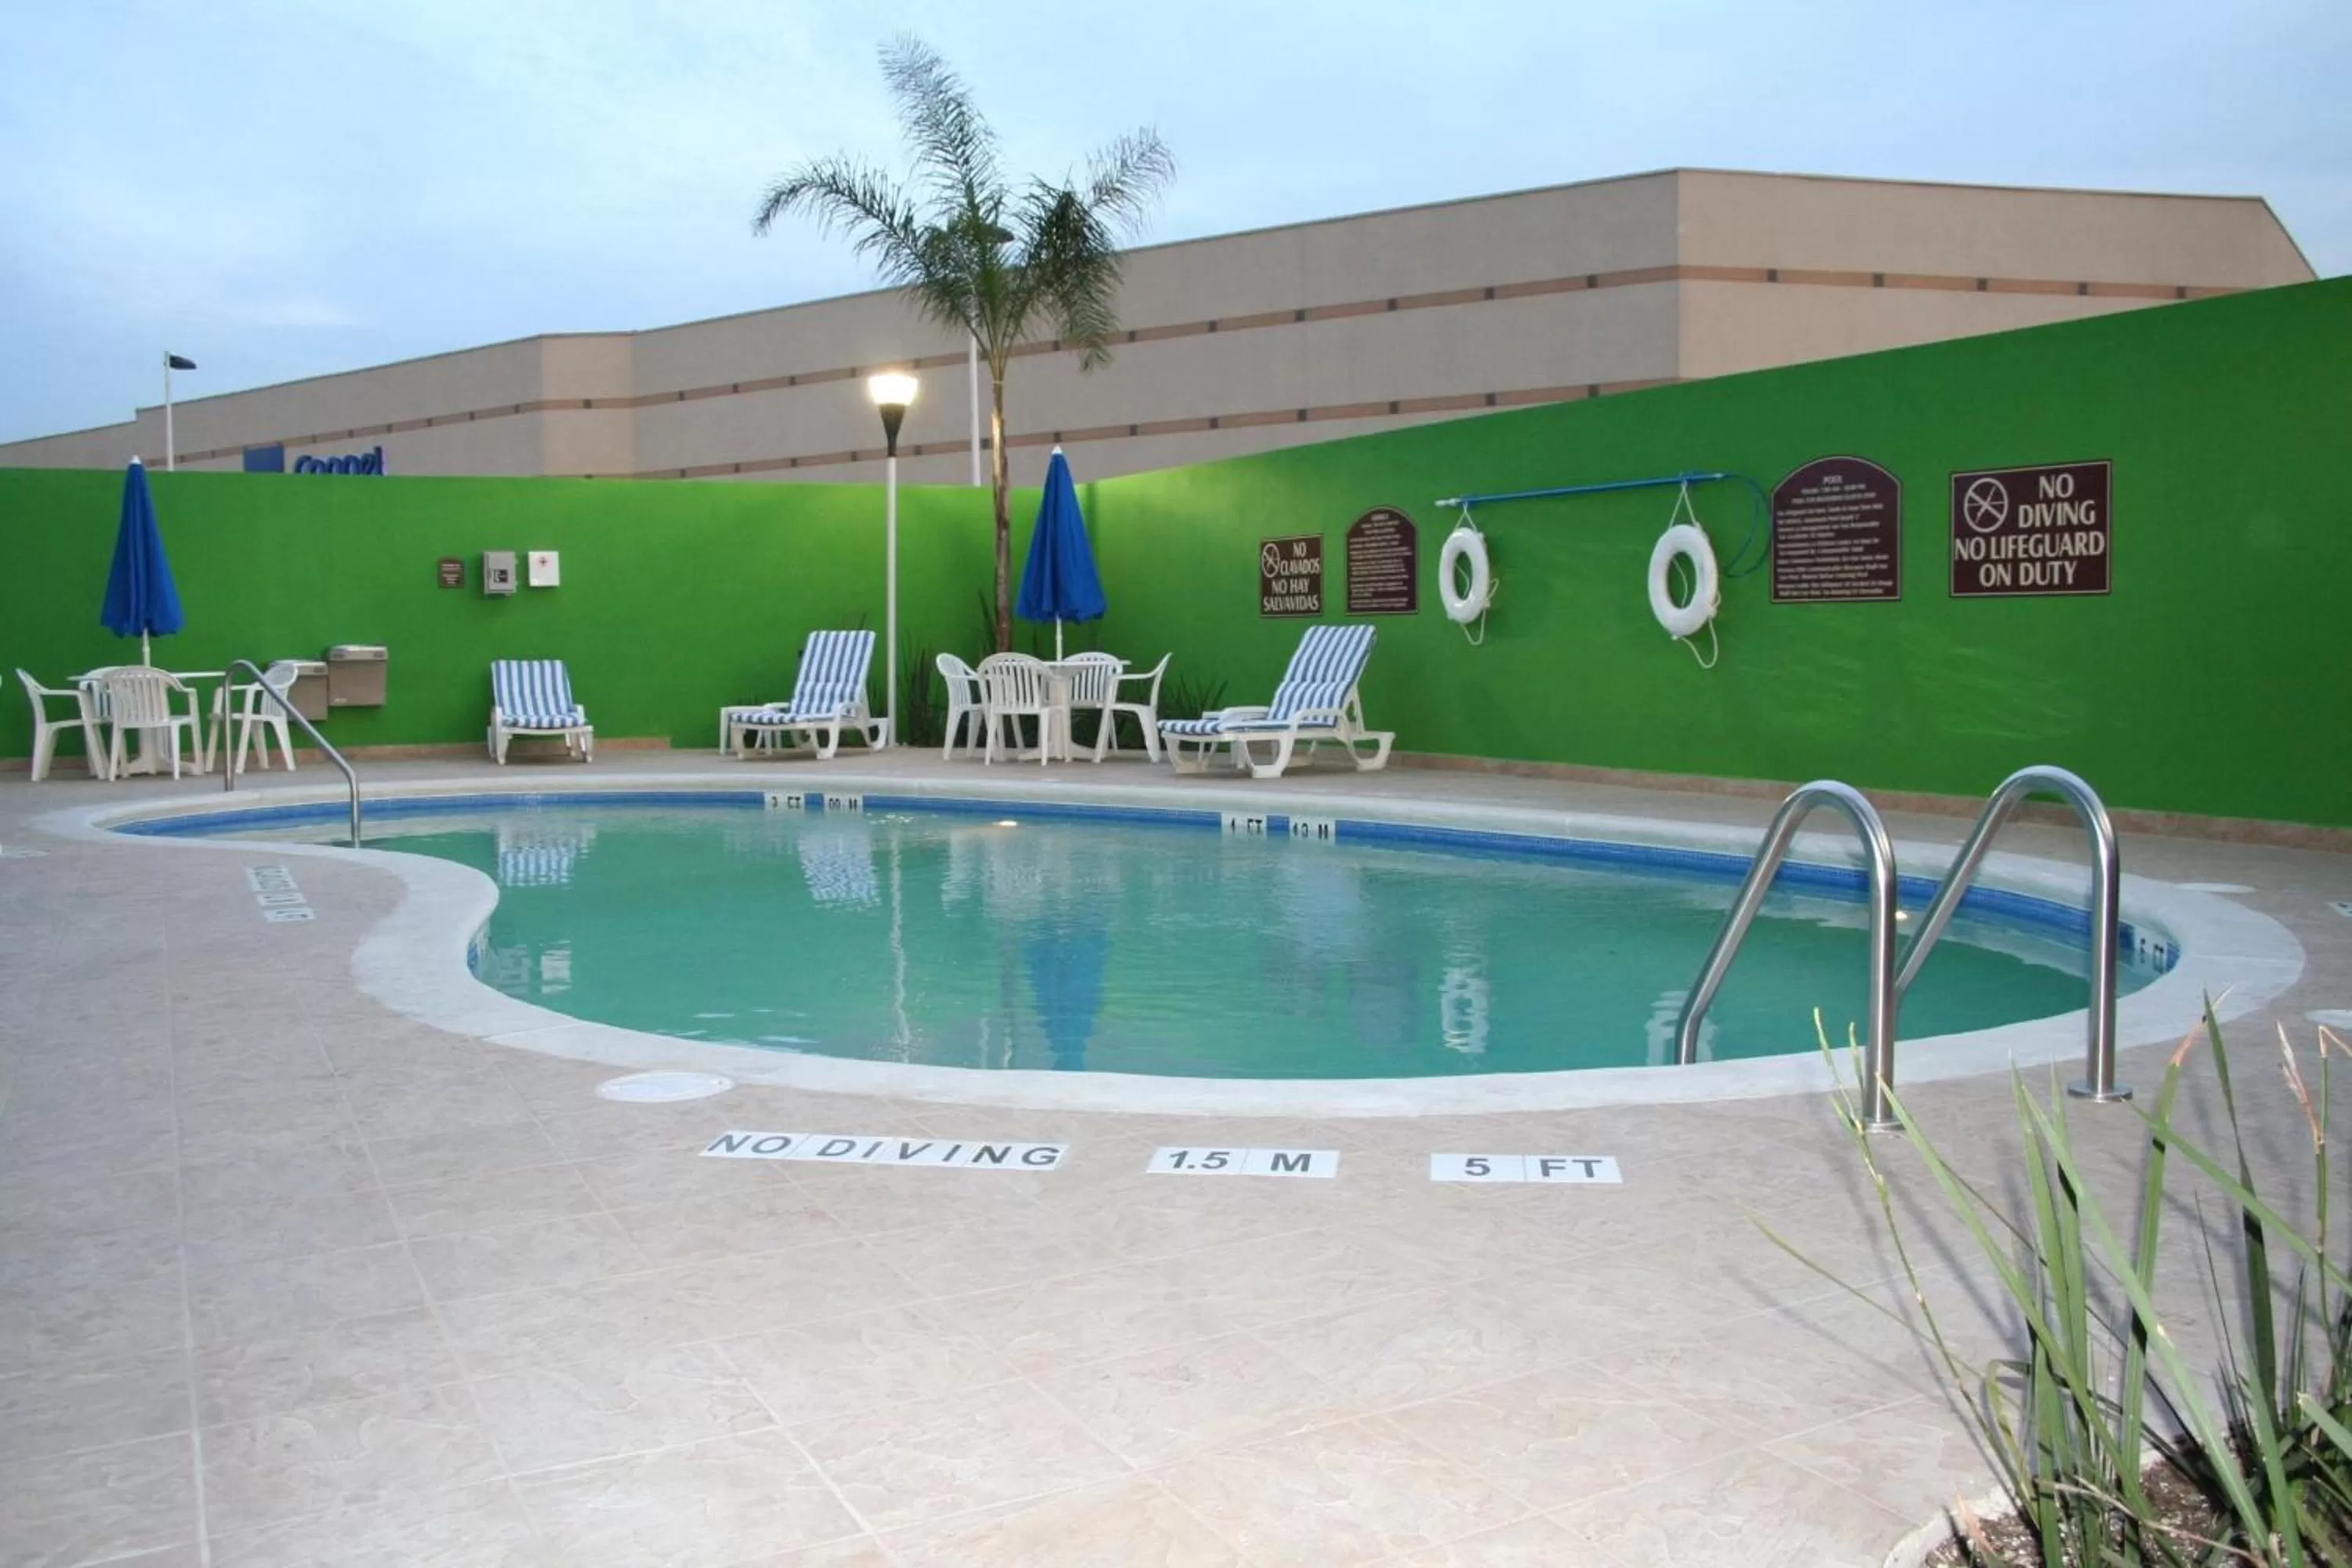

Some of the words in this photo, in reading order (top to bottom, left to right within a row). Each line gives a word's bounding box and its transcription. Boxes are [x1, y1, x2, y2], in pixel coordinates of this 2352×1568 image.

[2039, 473, 2074, 499] NO
[2018, 500, 2096, 528] DIVING
[1293, 541, 1307, 557] NO
[1955, 536, 1986, 561] NO
[1991, 531, 2105, 559] LIFEGUARD
[1280, 557, 1320, 575] CLAVADOS
[1979, 563, 2012, 587] ON
[2019, 561, 2077, 586] DUTY
[1272, 579, 1287, 594] NO
[1290, 577, 1310, 593] HAY
[1264, 593, 1319, 612] SALVAVIDAS
[707, 1134, 793, 1154] NO
[816, 1138, 1061, 1166] DIVING
[1168, 1150, 1230, 1170] 1.5
[1270, 1152, 1312, 1173] M
[1465, 1157, 1490, 1177] 5
[1540, 1159, 1602, 1178] FT
